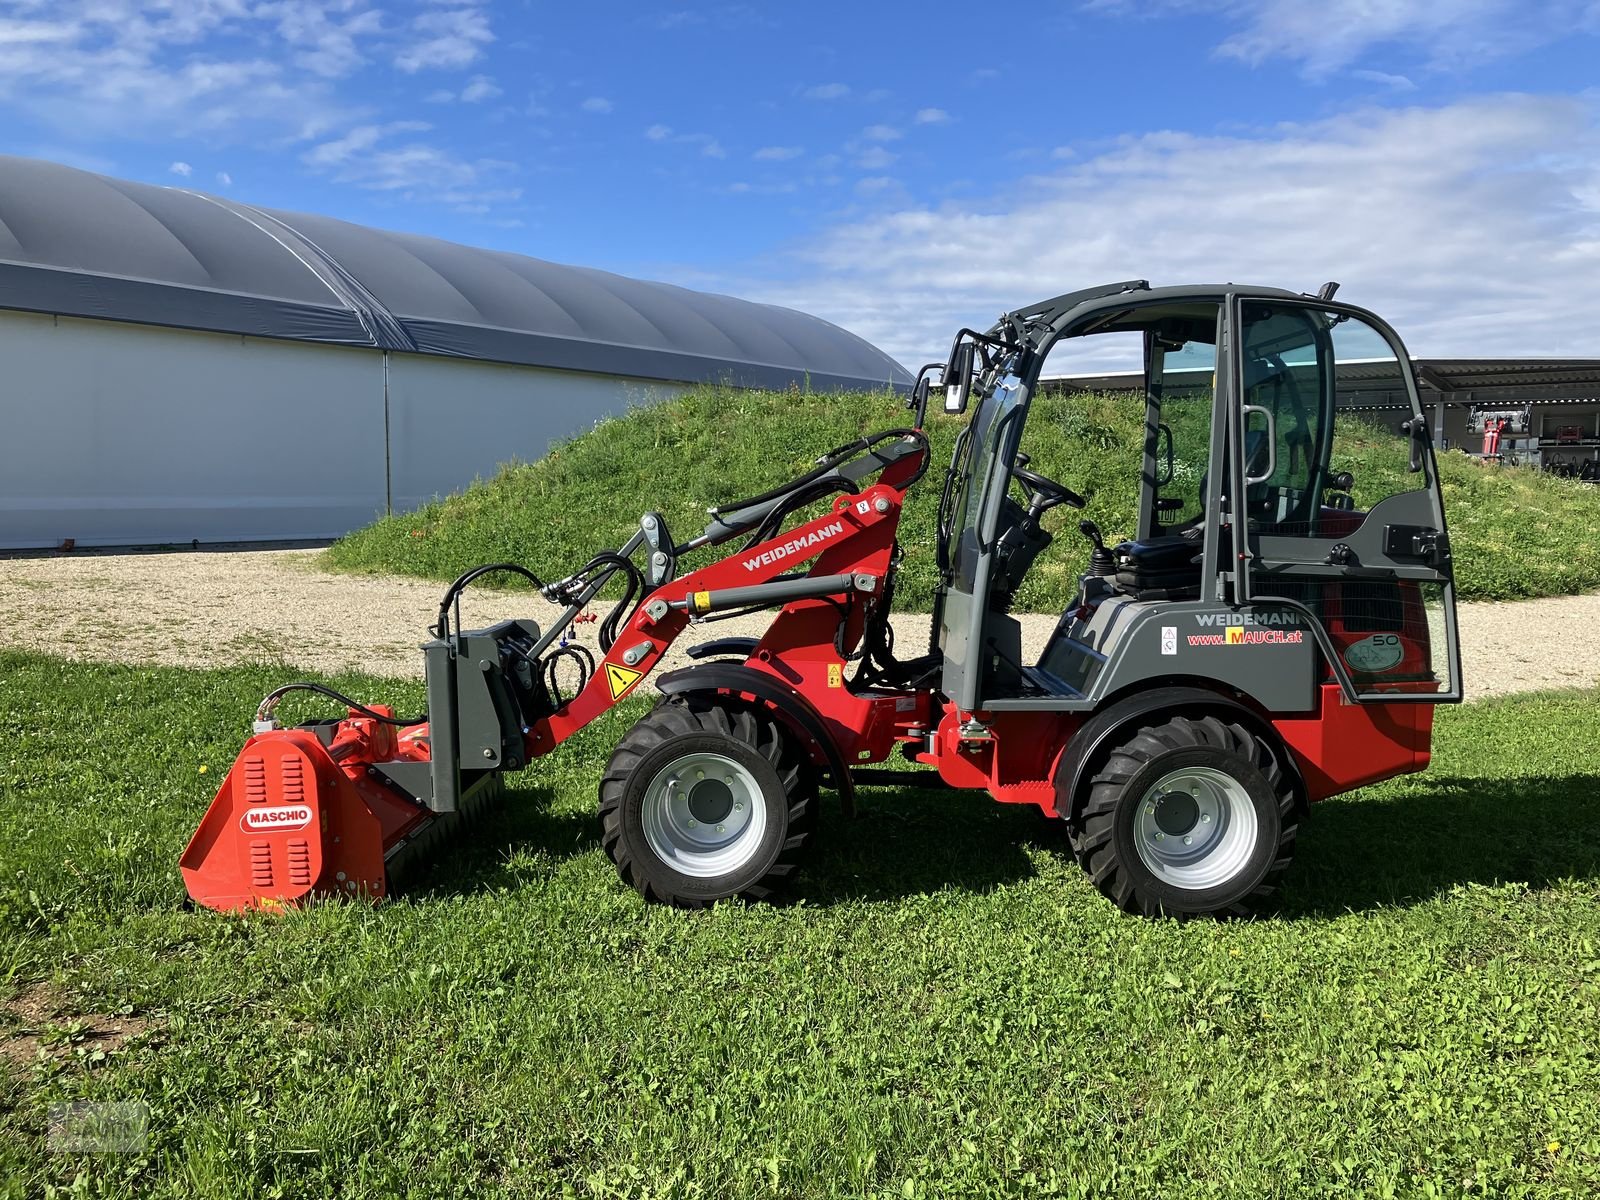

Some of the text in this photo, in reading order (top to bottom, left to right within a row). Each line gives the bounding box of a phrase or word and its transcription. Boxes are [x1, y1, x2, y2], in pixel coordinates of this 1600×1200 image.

[742, 521, 844, 572] WEIDEMANN
[1373, 634, 1399, 647] 50
[250, 810, 308, 823] MASCHIO
